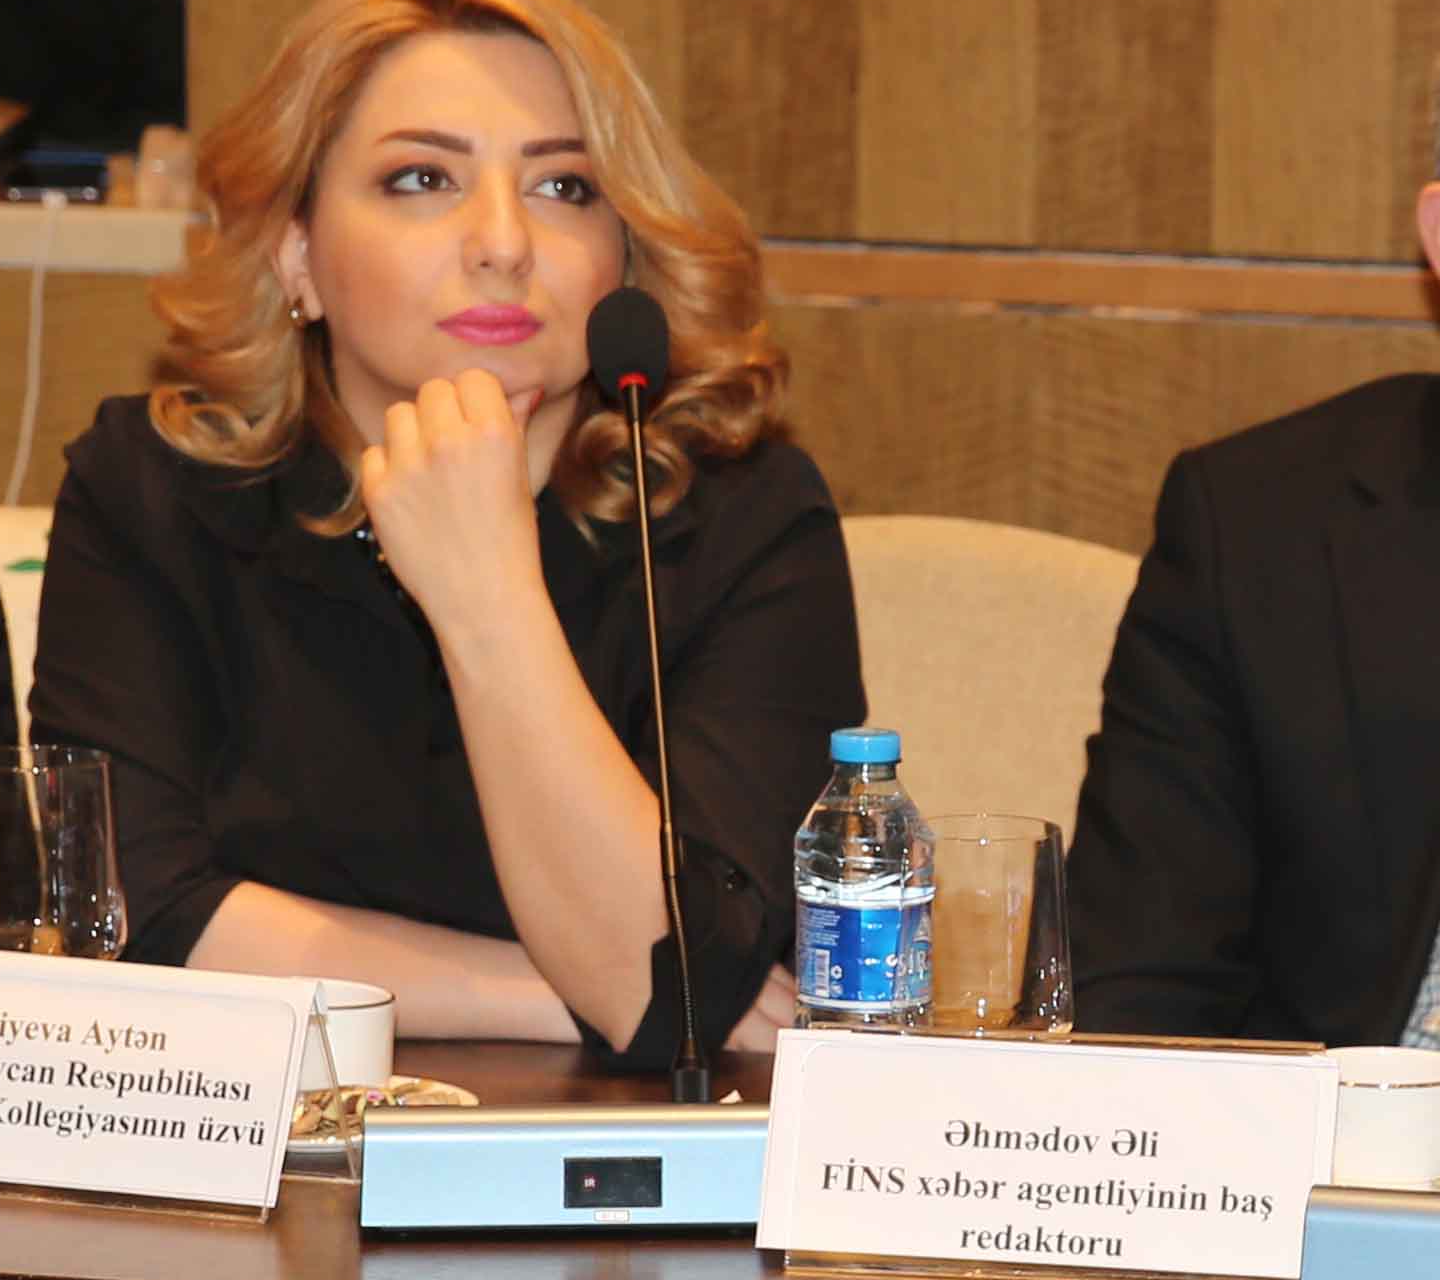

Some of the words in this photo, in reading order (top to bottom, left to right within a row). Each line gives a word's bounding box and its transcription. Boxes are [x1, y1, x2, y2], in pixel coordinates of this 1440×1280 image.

[81, 1020, 167, 1054] Aytən
[66, 1061, 252, 1101] Respublikası
[198, 1117, 265, 1145] üzvü
[945, 1120, 1100, 1155] Əhmədov
[1111, 1128, 1159, 1157] Əli
[822, 1158, 906, 1195] FİNS
[918, 1172, 1006, 1200] xəbər
[1017, 1178, 1207, 1215] agentliyinin
[1220, 1188, 1274, 1220] baş
[961, 1225, 1123, 1257] redaktoru
